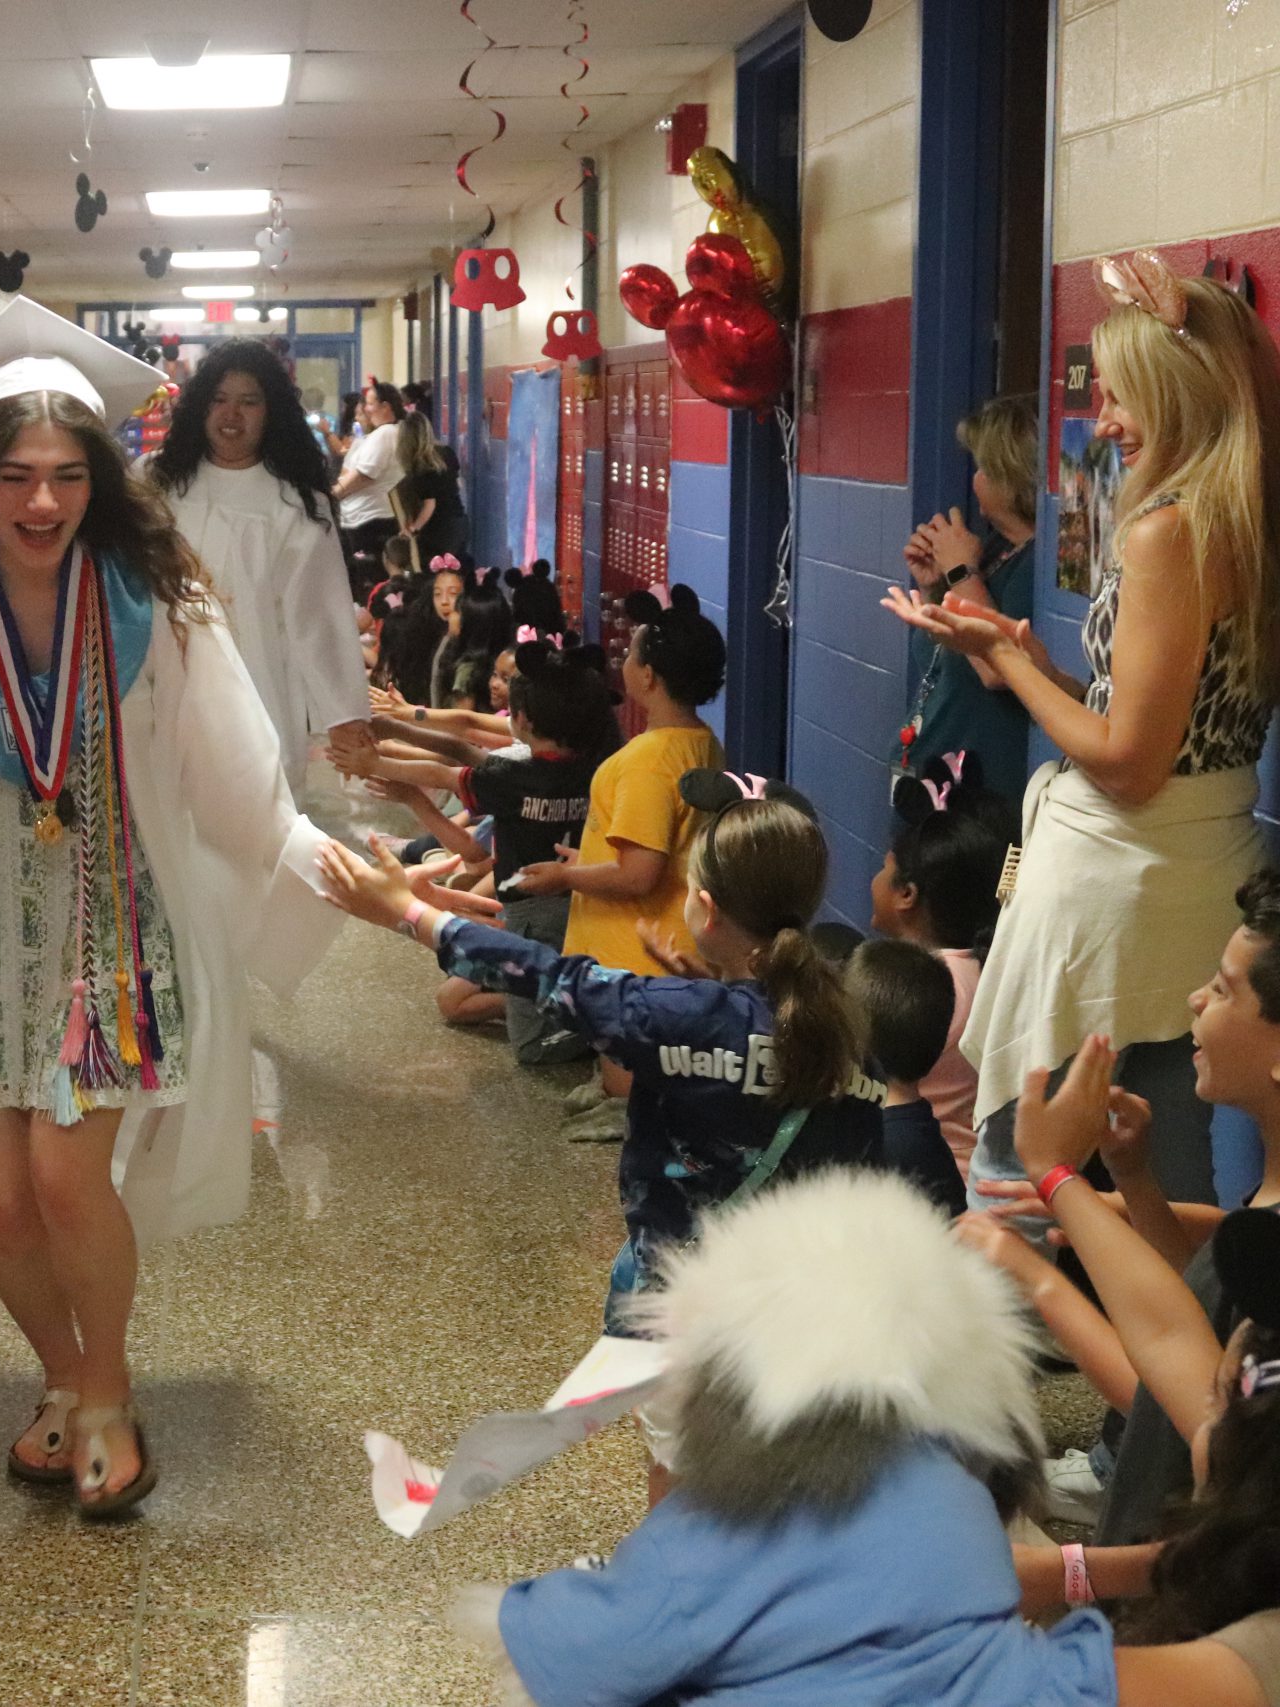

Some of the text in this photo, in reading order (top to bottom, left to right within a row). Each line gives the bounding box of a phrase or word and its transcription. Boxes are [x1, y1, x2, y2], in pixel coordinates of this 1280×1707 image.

[1067, 365, 1087, 390] 207
[521, 796, 567, 822] ANCHOR
[659, 1045, 744, 1083] Walt
